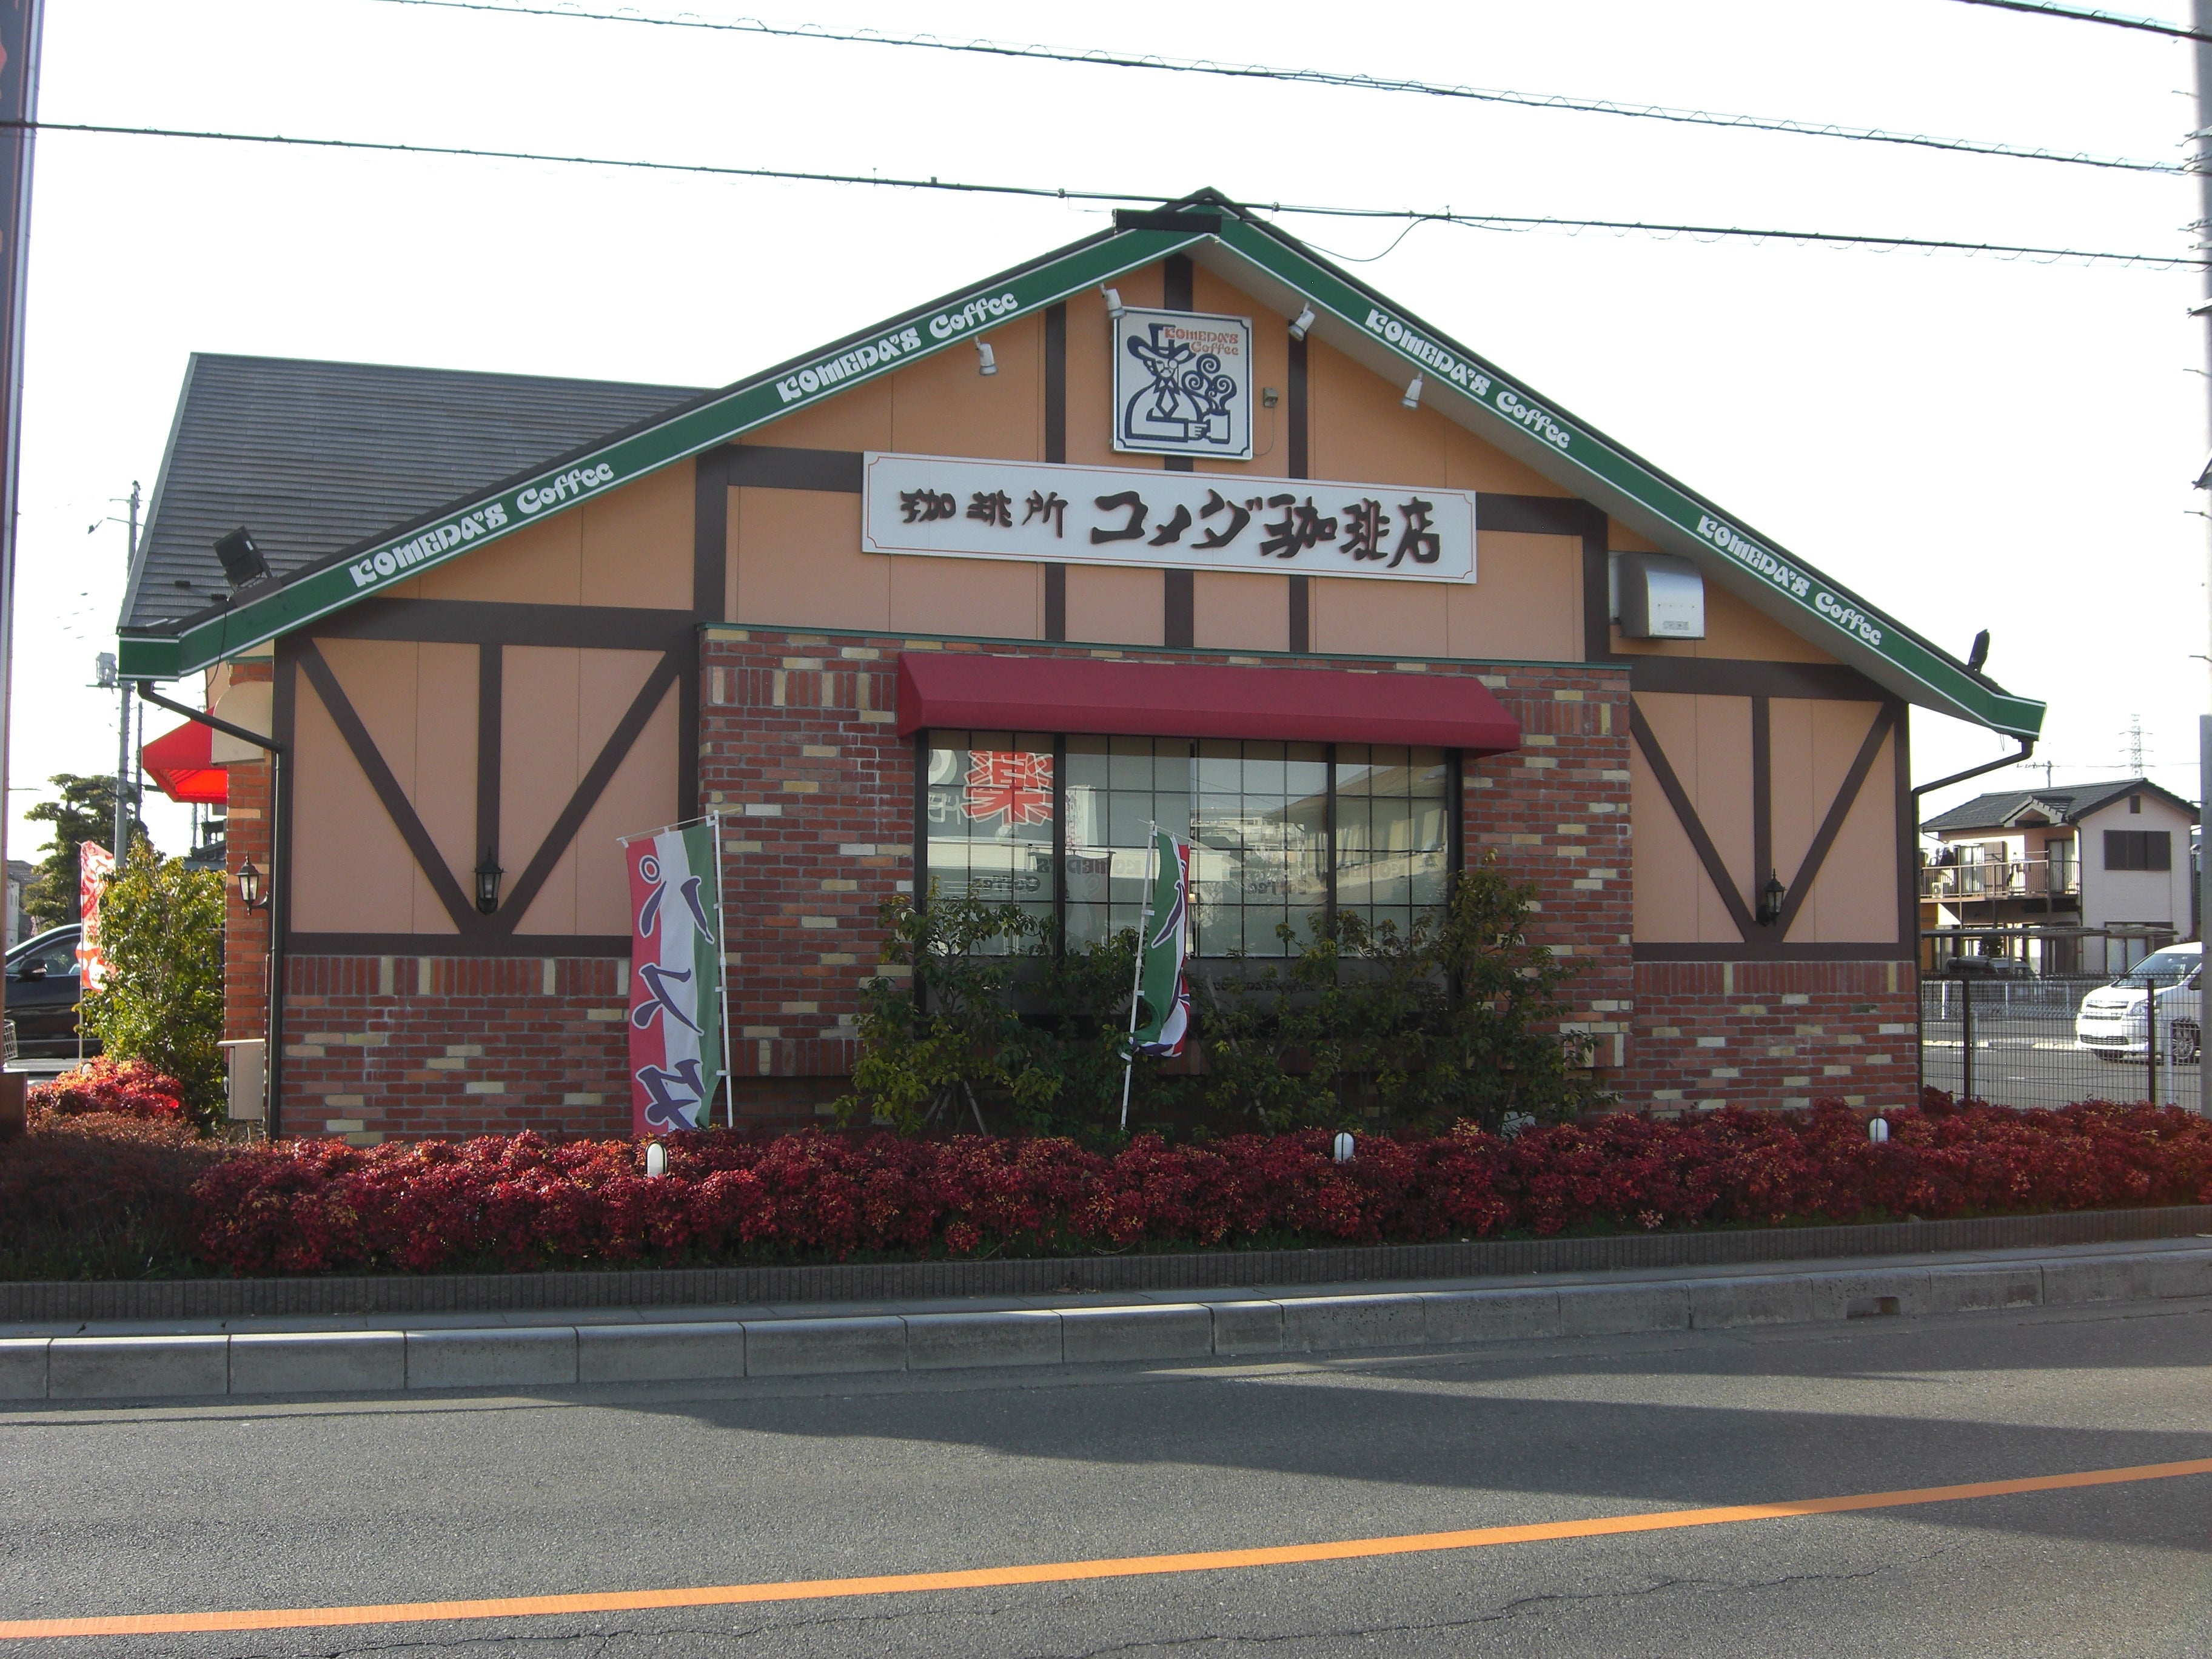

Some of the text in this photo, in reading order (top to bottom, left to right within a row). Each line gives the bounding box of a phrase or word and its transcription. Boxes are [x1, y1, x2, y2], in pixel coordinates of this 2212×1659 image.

[776, 292, 1019, 403] KOMEDA'S Coffee
[1164, 327, 1239, 344] KOMEDA'S
[1190, 341, 1239, 355] Coffee
[1364, 308, 1571, 449] KOMEDA'S Coffee
[348, 462, 615, 588] KOMEDA'S Coffee
[1090, 488, 1441, 568] コメダ珈琲店
[1697, 514, 1882, 646] KOMEDA'S Coffee
